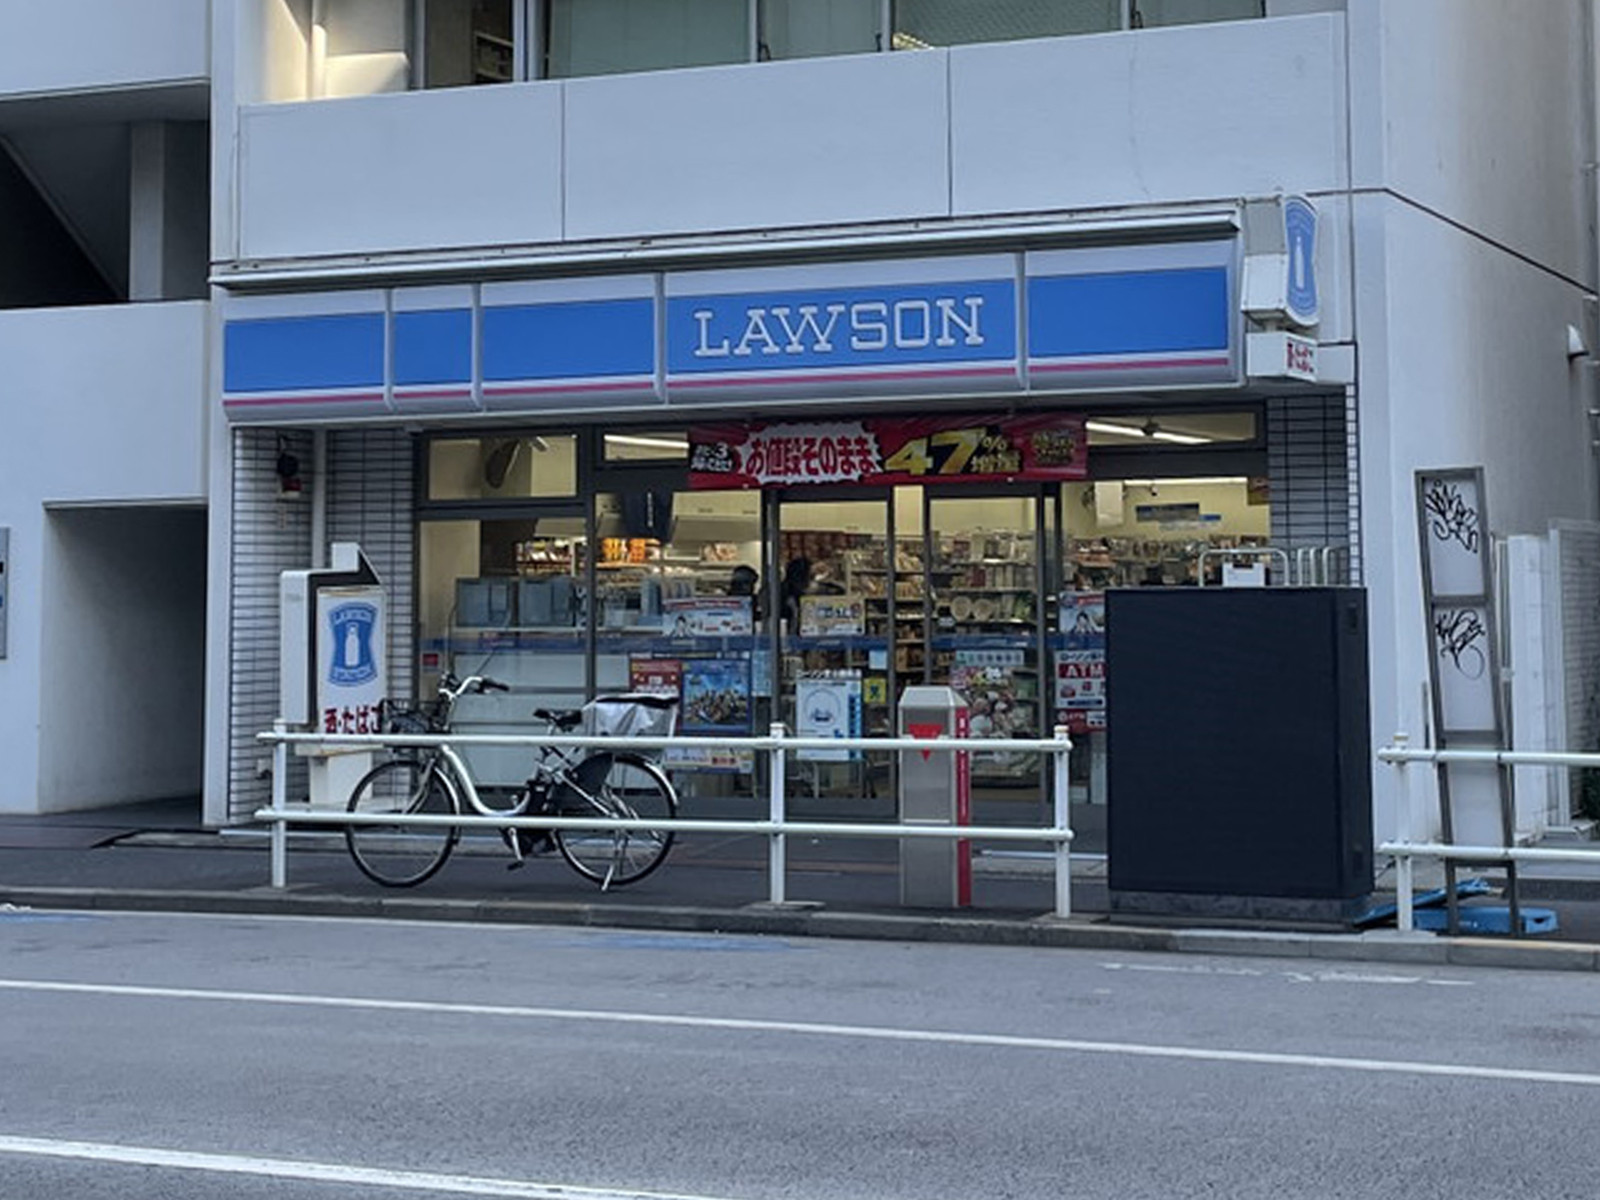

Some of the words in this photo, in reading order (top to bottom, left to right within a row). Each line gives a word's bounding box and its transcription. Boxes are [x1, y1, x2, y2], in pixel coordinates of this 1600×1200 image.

[694, 296, 985, 357] LAWSON
[746, 434, 877, 477] お値段そのまま
[1066, 664, 1104, 678] ATM
